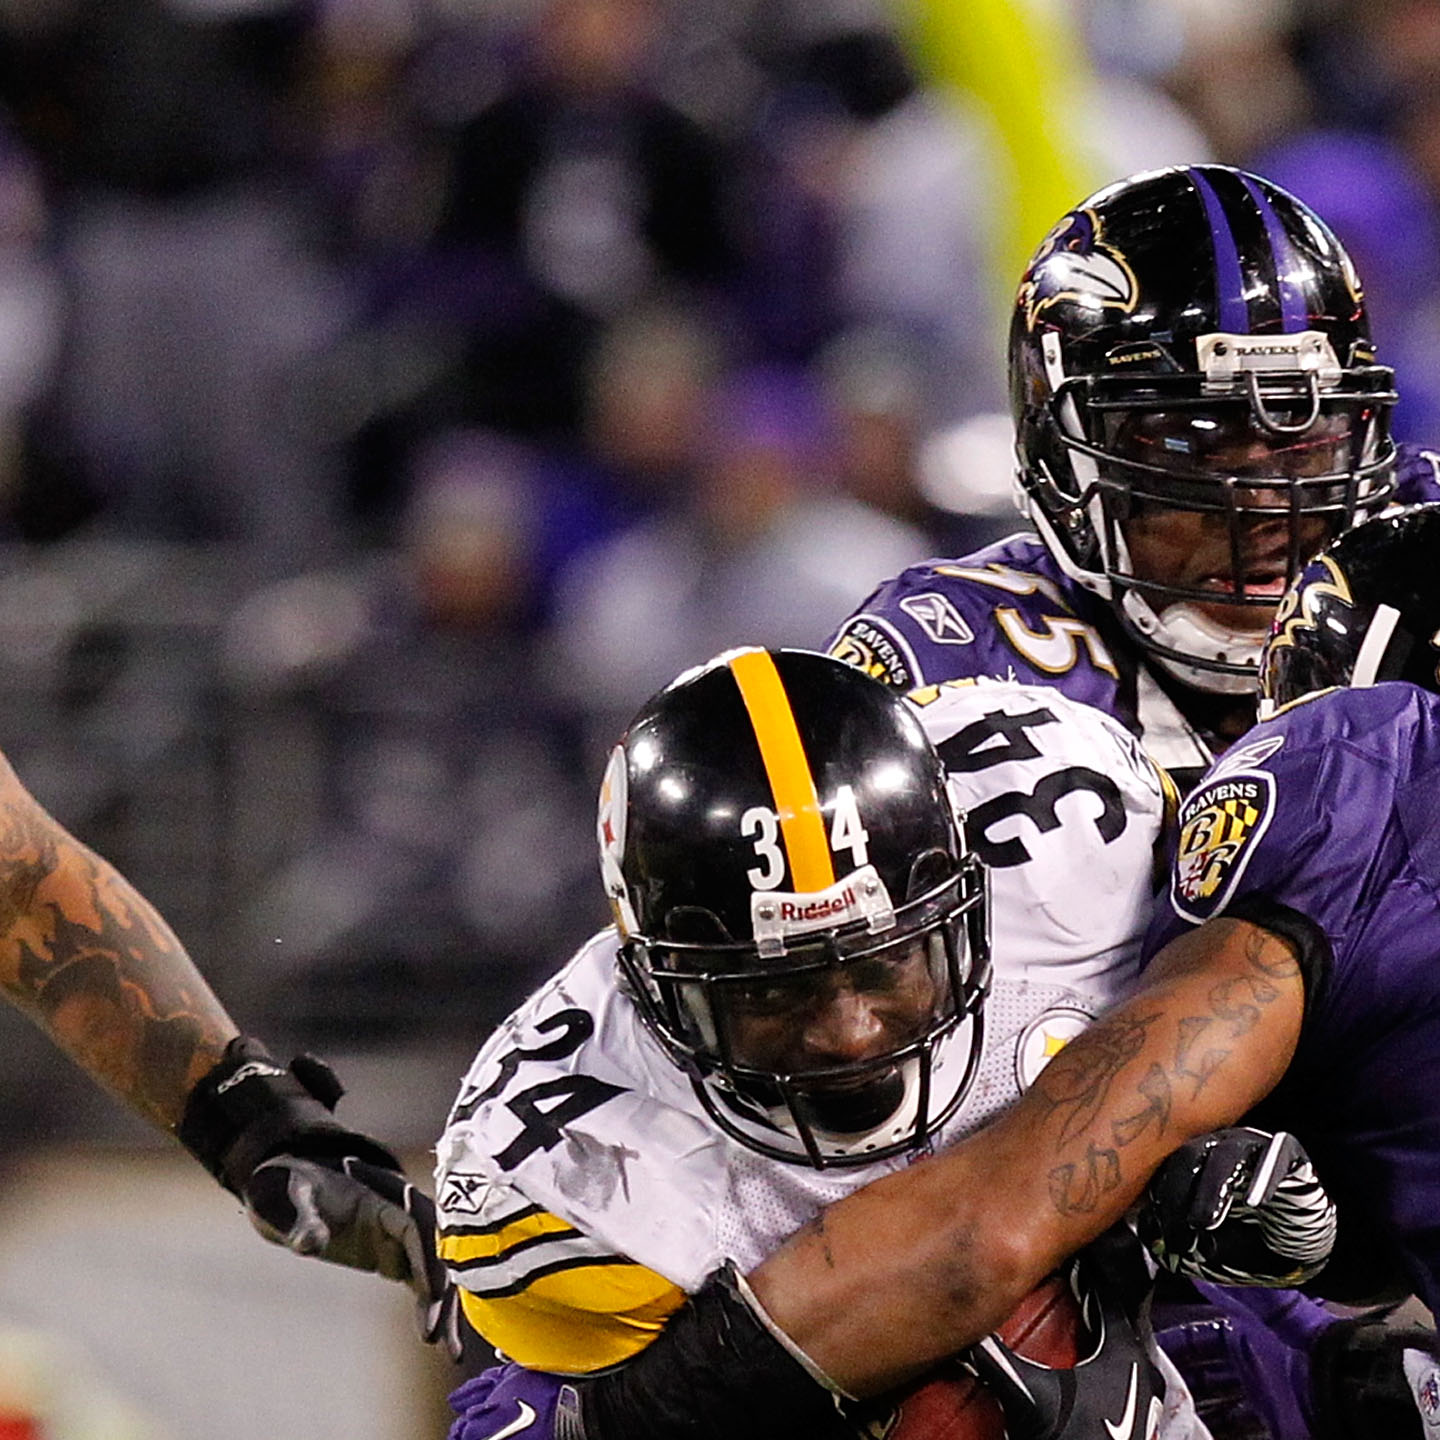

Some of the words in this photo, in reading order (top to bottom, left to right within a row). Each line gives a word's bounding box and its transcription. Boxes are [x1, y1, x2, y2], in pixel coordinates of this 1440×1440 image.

[1109, 350, 1161, 367] RAVENS
[1235, 345, 1300, 357] RAVENS
[851, 621, 908, 686] RAVENS
[935, 707, 1128, 868] 34
[1185, 783, 1258, 821] RAVENS
[741, 785, 869, 890] 34
[781, 887, 856, 921] Riddell
[448, 1008, 636, 1172] 34
